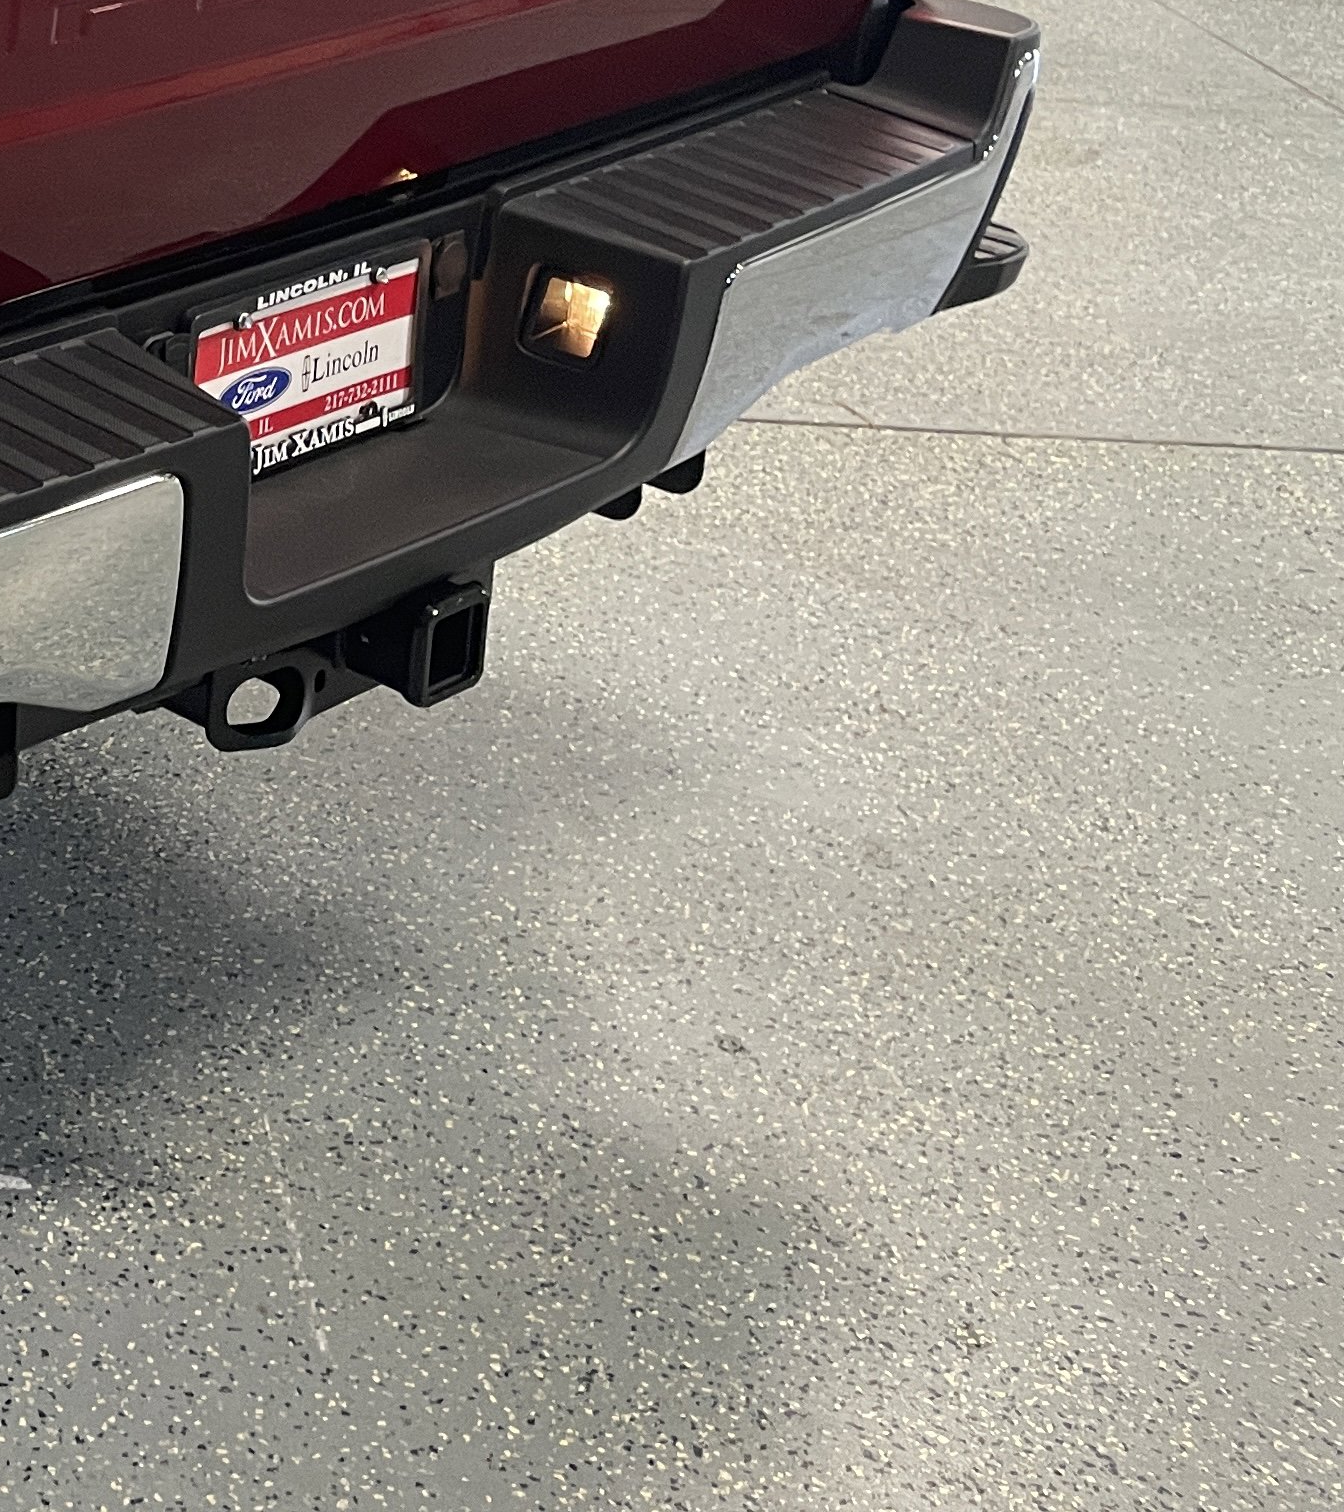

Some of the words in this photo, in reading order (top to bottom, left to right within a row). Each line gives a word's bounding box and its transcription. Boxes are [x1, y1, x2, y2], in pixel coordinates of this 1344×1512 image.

[256, 269, 348, 310] LINCOLN,
[354, 261, 372, 276] IL
[218, 292, 385, 376] JIMXAMIS.COM
[311, 340, 379, 383] Lincoln
[231, 373, 278, 410] Ford
[324, 373, 399, 412] 217-732-2111
[252, 442, 289, 476] JIM
[291, 417, 356, 458] XAMIS
[257, 418, 274, 436] IL
